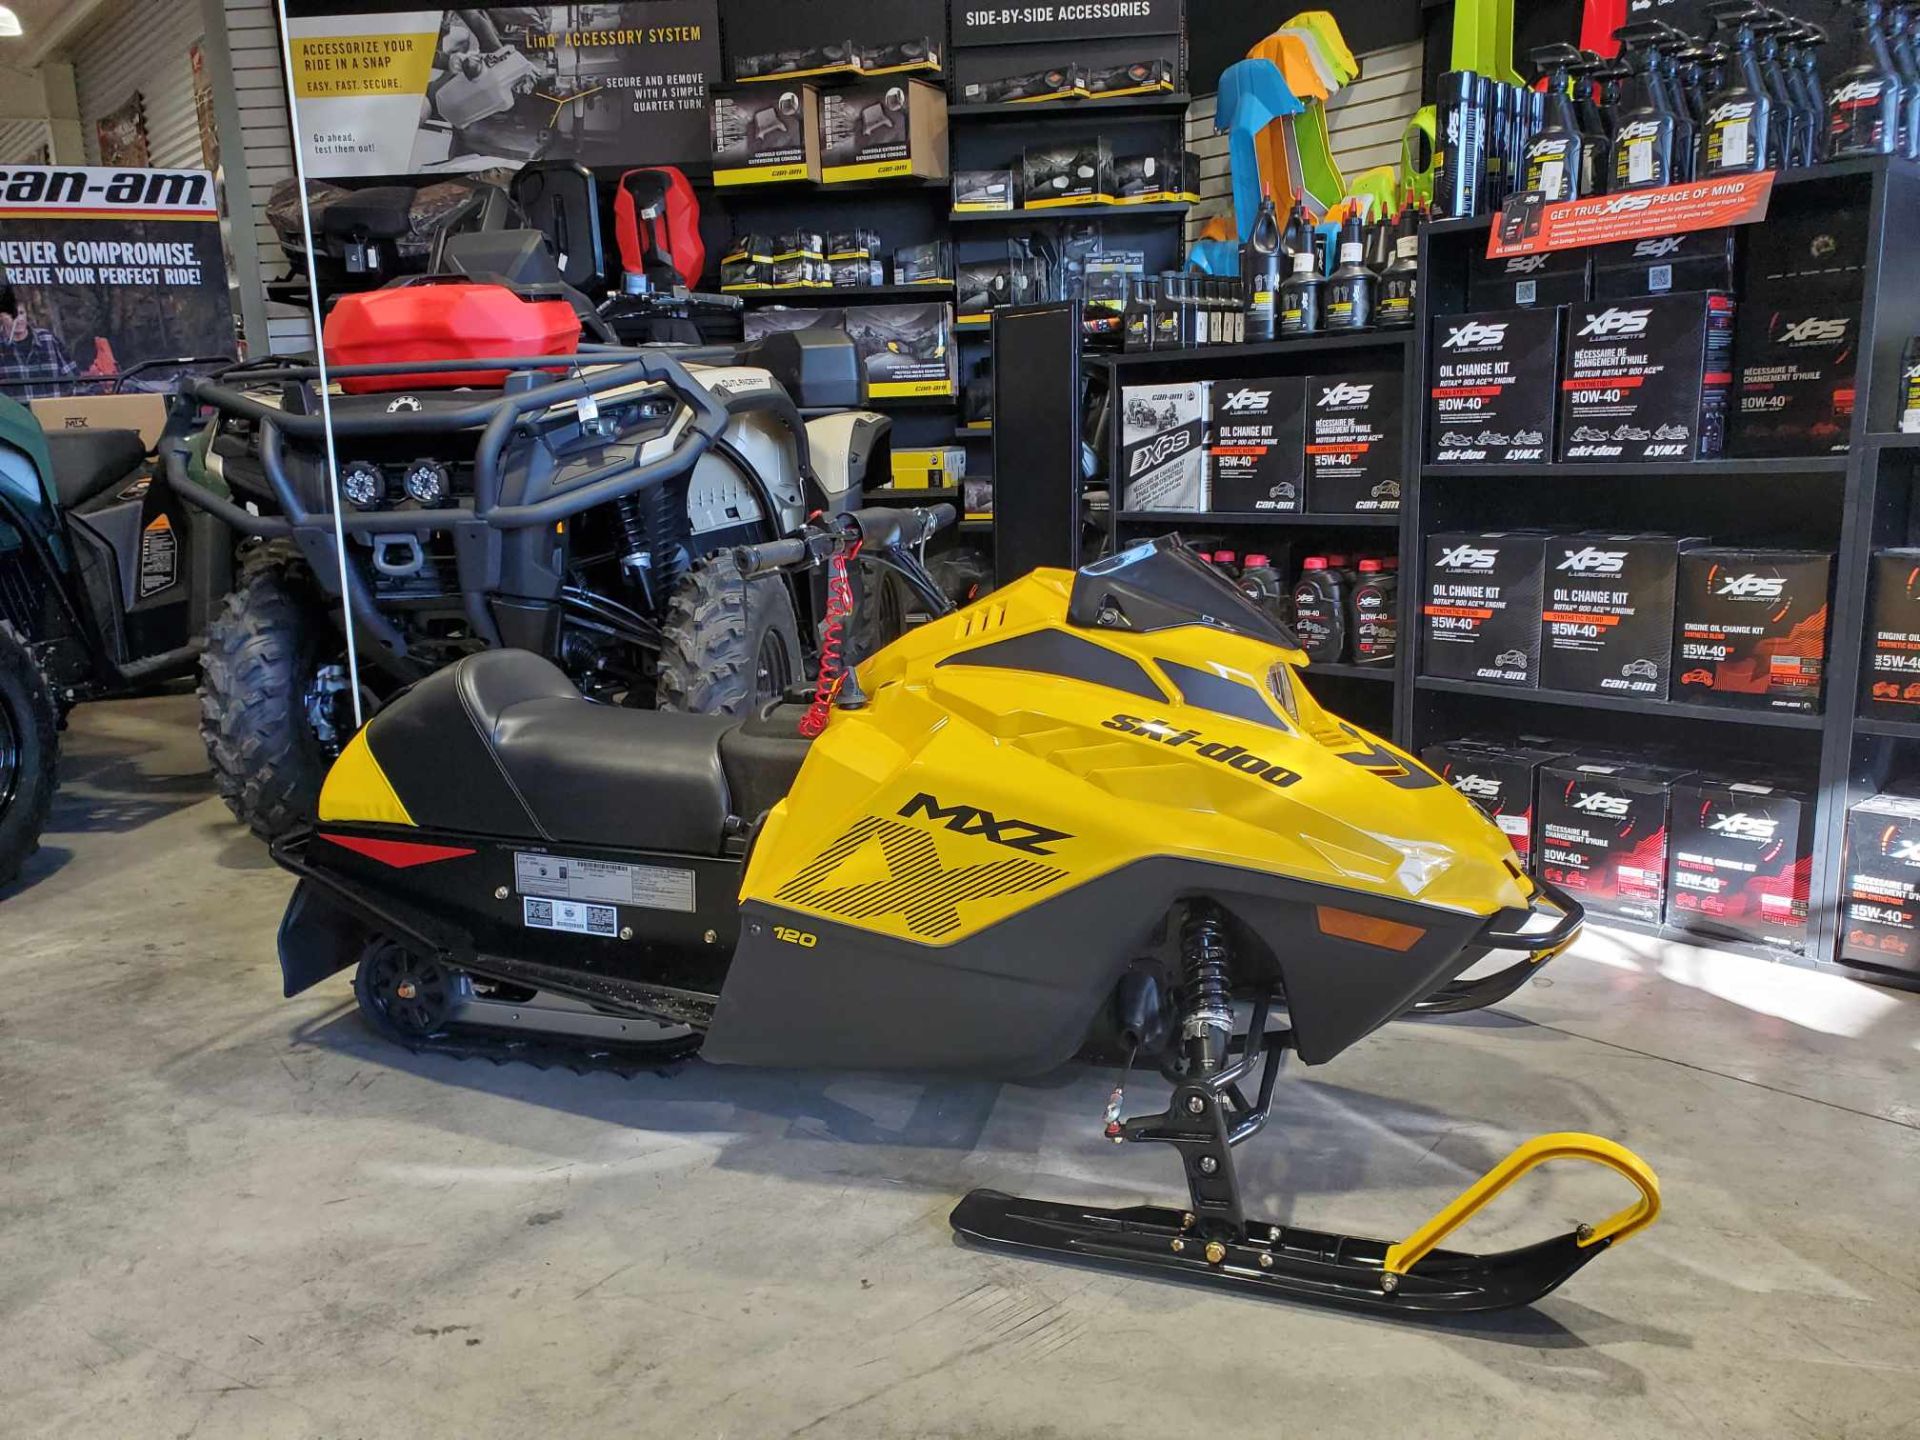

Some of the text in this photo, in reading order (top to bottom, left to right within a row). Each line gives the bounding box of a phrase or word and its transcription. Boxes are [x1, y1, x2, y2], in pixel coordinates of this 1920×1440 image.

[966, 2, 1150, 26] SIDE-BY-SIDE ACCESSORIES
[565, 26, 701, 46] ACCESSORY SYSTEM
[303, 39, 413, 55] ACCESSORIZE YOUR
[304, 56, 391, 71] RIDE IN A SNAP
[307, 78, 401, 92] EASY. FAST. SECURE.
[607, 73, 703, 88] SECURE AND REMOVE
[635, 86, 704, 99] WITH A SIMPLE
[1829, 81, 1885, 105] XPS
[633, 99, 705, 112] QUARTER TURN.
[1706, 102, 1756, 125] XPS
[314, 134, 324, 143] Go
[1615, 120, 1661, 143] XPS
[315, 145, 331, 154] test
[335, 144, 355, 153] them
[1526, 139, 1570, 160] XPS
[772, 168, 802, 176] can-am
[878, 165, 907, 173] can-am
[1551, 183, 1745, 221] GET TRUE XPS PEACE OF MIND
[0, 241, 201, 265] NEVER COMPROMISE.
[6, 267, 202, 286] REATE YOUR PERFECT RIDE!
[1577, 307, 1653, 336] XPS
[1442, 321, 1509, 347] XPS
[1776, 317, 1851, 342] XPS
[1589, 332, 1647, 342] LUBRICANTS
[1575, 348, 1627, 359] NÉCESSAIRE DE
[1574, 354, 1648, 368] CHANGEMENT D'HUILE
[1440, 361, 1510, 377] OIL CHANGE KIT
[1574, 370, 1600, 378] MOTEUR
[1787, 365, 1798, 373] DE
[1493, 376, 1516, 384] ENGINE
[1744, 371, 1821, 383] CHANGEMENT D'HUILE
[1221, 388, 1272, 410] XPS
[1317, 383, 1373, 406] XPS
[1580, 389, 1620, 403] 0W-40
[1445, 398, 1481, 410] 0W-40
[1748, 396, 1785, 408] 0W-40
[1348, 418, 1355, 426] DE
[1220, 425, 1273, 437] OIL CHANGE KIT
[1315, 426, 1349, 435] CHANGEMENT
[1141, 430, 1190, 470] XPS
[1437, 449, 1544, 460] ski-doo LYNX
[1567, 444, 1688, 457] ski-doo LYNX
[1224, 456, 1251, 467] 5W-40
[1321, 454, 1351, 466] 5W-40
[1255, 501, 1295, 509] can-am
[1355, 500, 1400, 509] can-am
[1435, 544, 1500, 568] XPS
[1556, 546, 1629, 572] XPS
[1433, 584, 1500, 599] OIL CHANGE KIT
[1715, 573, 1788, 596] XPS
[1554, 588, 1629, 605] OIL CHANGE KIT
[1484, 601, 1507, 609] ENGINE
[1611, 607, 1636, 615] ENGINE
[1439, 617, 1472, 630] 5W-40
[1560, 623, 1597, 637] 5W-40
[1685, 623, 1764, 635] ENGINE OIL CHANGE KIT
[1878, 631, 1920, 642] ENGINE OIL
[1689, 644, 1726, 657] 5W-40
[1883, 654, 1920, 669] 5W-4
[1476, 668, 1527, 681] can-am
[1601, 678, 1657, 692] can-am
[1452, 774, 1503, 795] XPS
[1572, 792, 1633, 814] XPS
[896, 792, 1078, 856] MXZ
[1708, 813, 1779, 836] XPS
[1545, 830, 1584, 843] CHANGEMENT
[1550, 849, 1582, 864] 0W-40
[1859, 904, 1902, 922] 5W-40
[773, 926, 817, 948] 120
